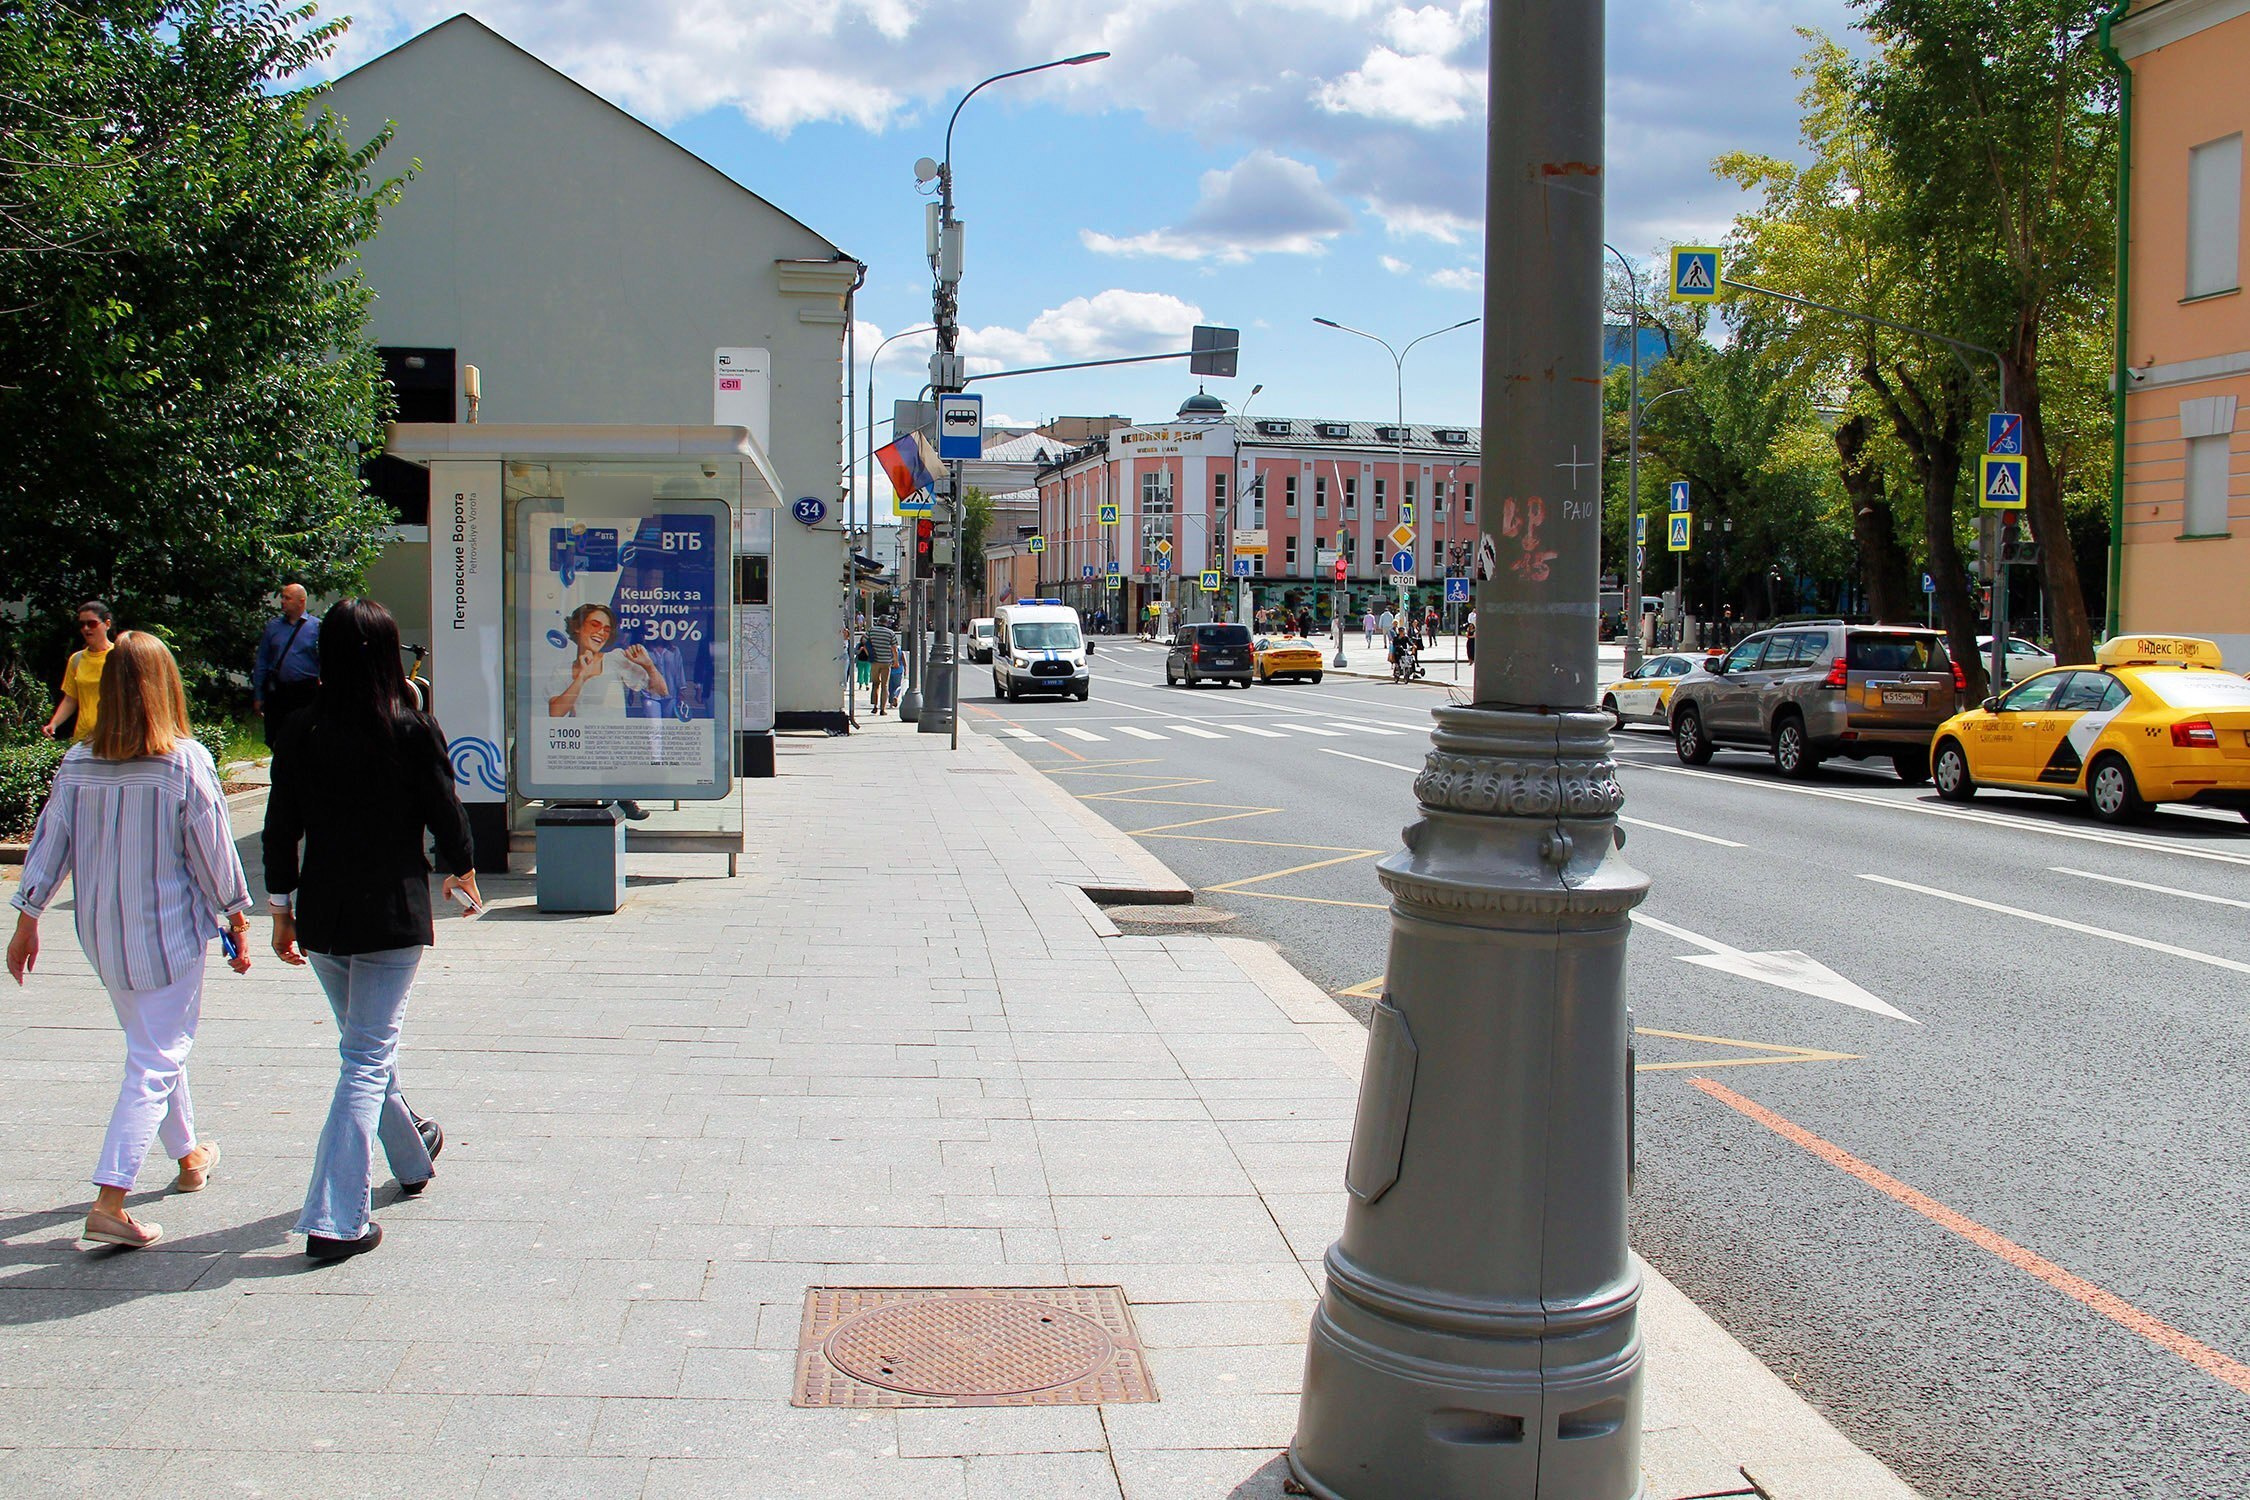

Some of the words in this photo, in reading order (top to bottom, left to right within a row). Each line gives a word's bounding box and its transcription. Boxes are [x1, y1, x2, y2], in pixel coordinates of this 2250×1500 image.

[1173, 431, 1203, 442] ДОМ
[469, 492, 477, 522] Vorota
[799, 502, 820, 516] 34
[453, 493, 467, 542] Ворота
[661, 531, 702, 551] ВТБ
[469, 524, 478, 574] Petrovskiye
[1392, 576, 1415, 584] СТОП
[453, 547, 467, 630] Петровские
[620, 587, 681, 601] Кешбэк
[683, 590, 701, 601] за
[620, 604, 689, 617] покупки
[619, 618, 641, 629] до
[644, 619, 702, 641] 30%
[2137, 639, 2172, 656] Яндекс
[2173, 640, 2199, 656] Такси
[557, 728, 581, 738] 1000
[2042, 720, 2056, 732] 206
[550, 740, 581, 750] VTB.RU
